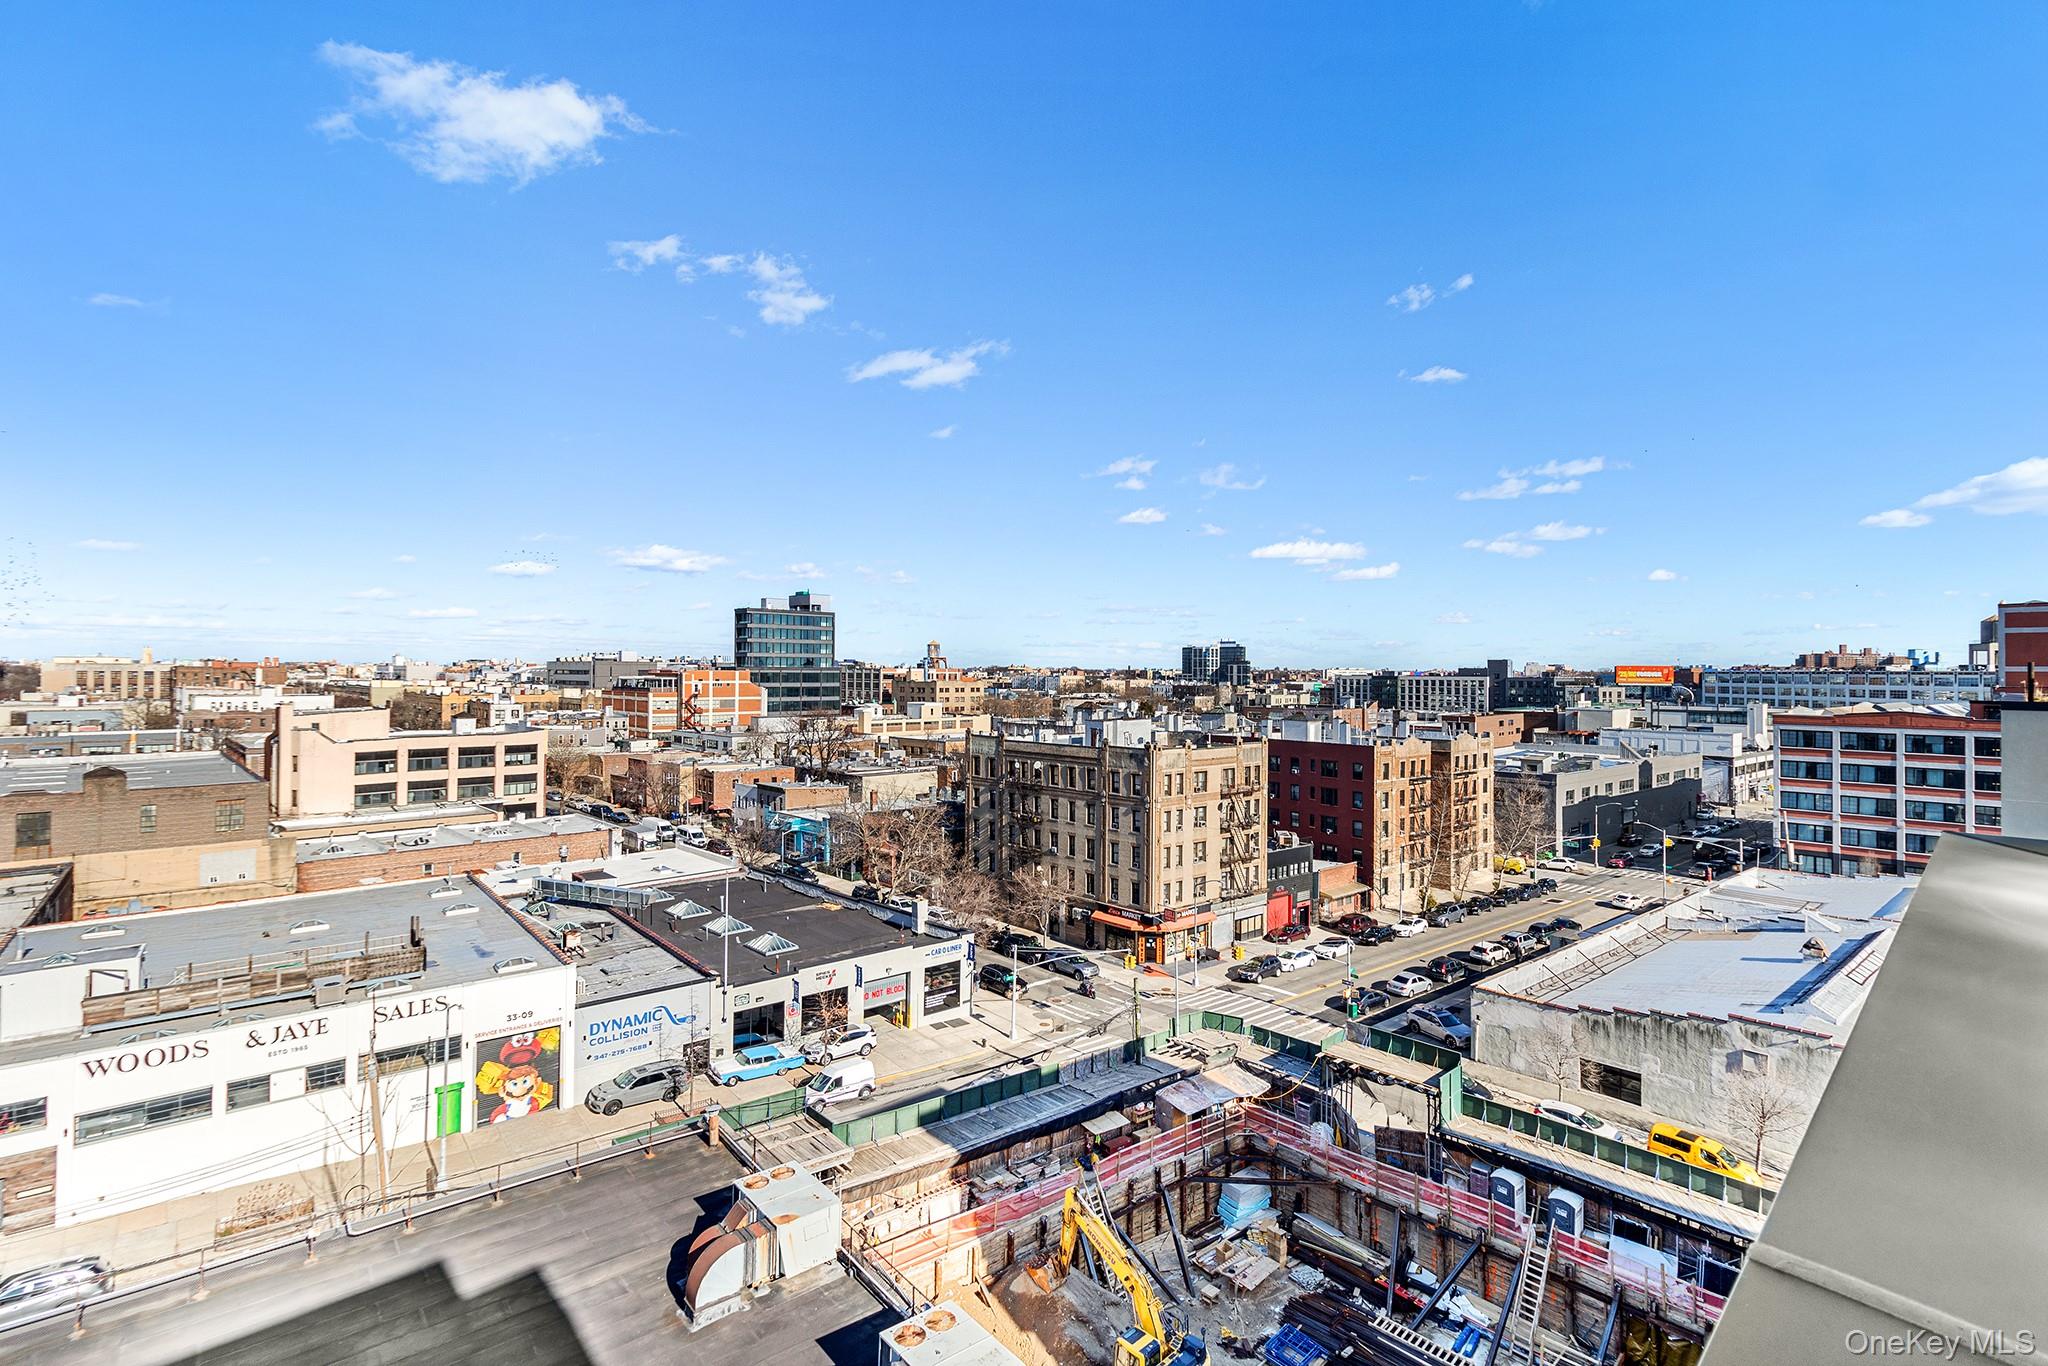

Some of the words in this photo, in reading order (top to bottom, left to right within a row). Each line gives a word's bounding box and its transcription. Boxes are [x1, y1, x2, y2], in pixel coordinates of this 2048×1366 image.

[872, 989, 883, 999] NOT
[886, 984, 905, 995] BLOCK
[507, 1010, 534, 1022] 33-09
[589, 1009, 663, 1036] DYNAMIC
[81, 1039, 209, 1078] WOODS
[246, 1030, 266, 1048] &
[271, 1017, 329, 1044] JAYE
[374, 995, 449, 1023] SALES
[475, 1029, 498, 1039] SERVICE
[499, 1023, 528, 1034] ENTRANCE
[533, 1017, 563, 1027] DELIVERIES
[589, 1027, 648, 1047] COLLISION
[1087, 1229, 1116, 1265] KOMATSU
